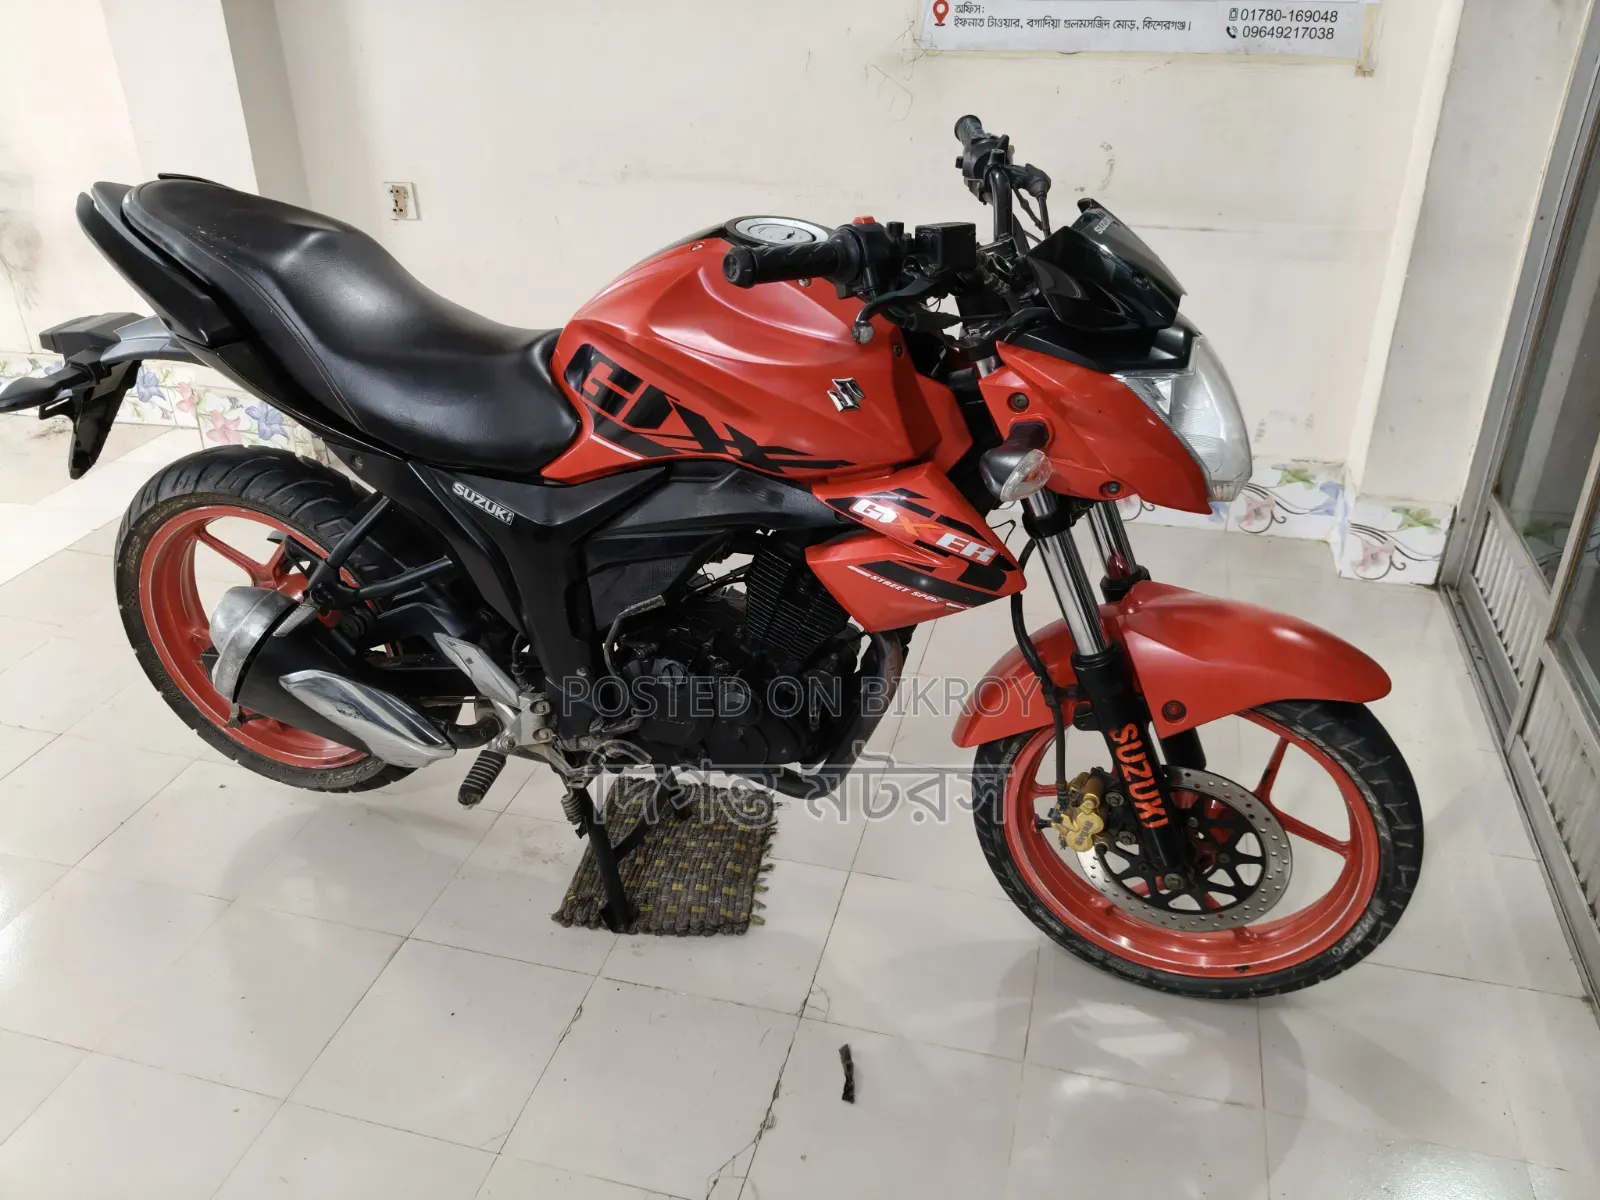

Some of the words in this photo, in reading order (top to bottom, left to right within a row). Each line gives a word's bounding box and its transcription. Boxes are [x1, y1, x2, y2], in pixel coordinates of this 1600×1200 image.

[954, 1, 985, 14] অফিস:
[1240, 8, 1338, 23] 01780-169048
[1242, 25, 1335, 40] 09649217038
[453, 483, 514, 524] SUZUKI
[870, 575, 911, 592] STREET
[1109, 723, 1169, 829] SUZUKI
